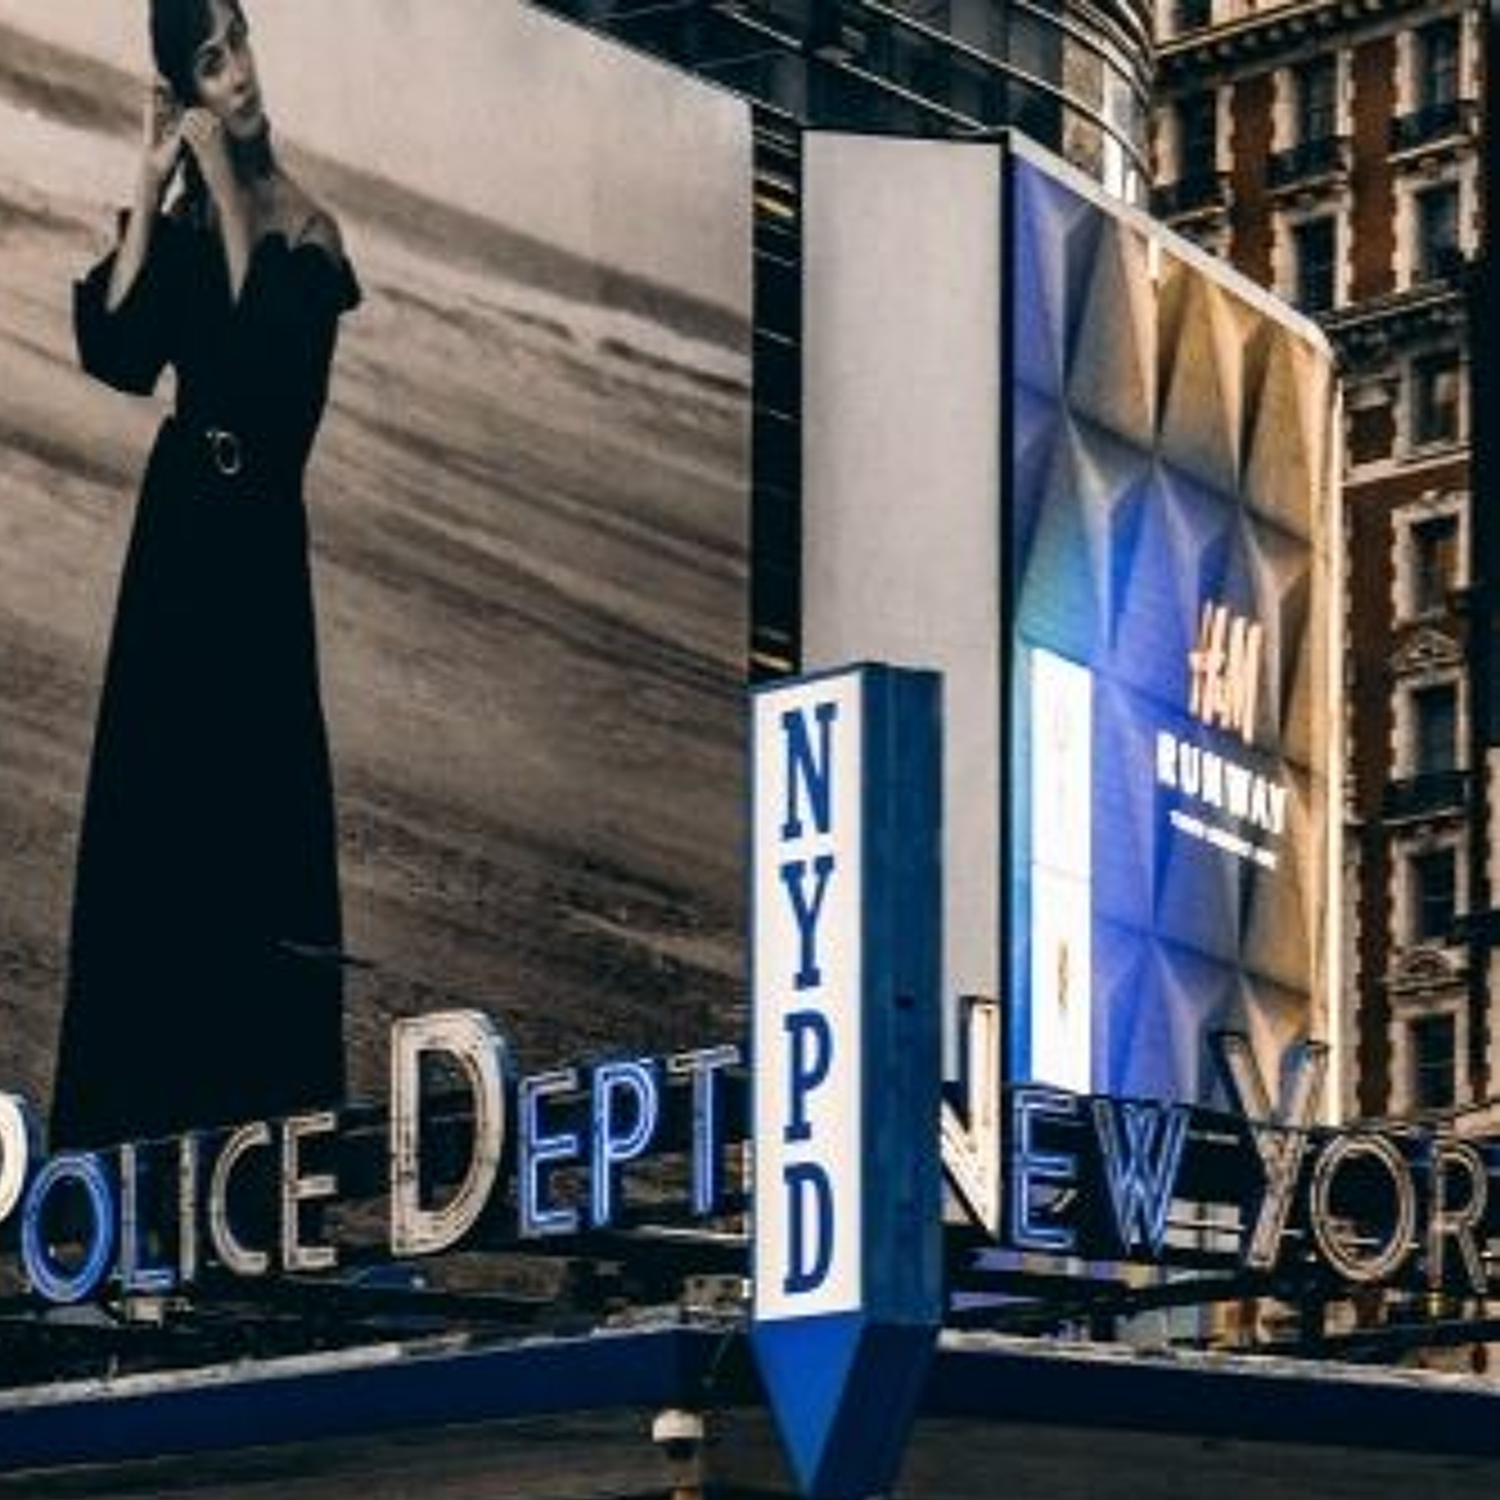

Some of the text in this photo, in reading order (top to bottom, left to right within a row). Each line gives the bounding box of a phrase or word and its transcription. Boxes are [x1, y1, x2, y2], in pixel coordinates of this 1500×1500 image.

[1156, 730, 1288, 834] RUNWAY
[779, 701, 838, 1297] NYPD
[940, 996, 1191, 1257] NEW
[391, 1007, 741, 1256] DEPT
